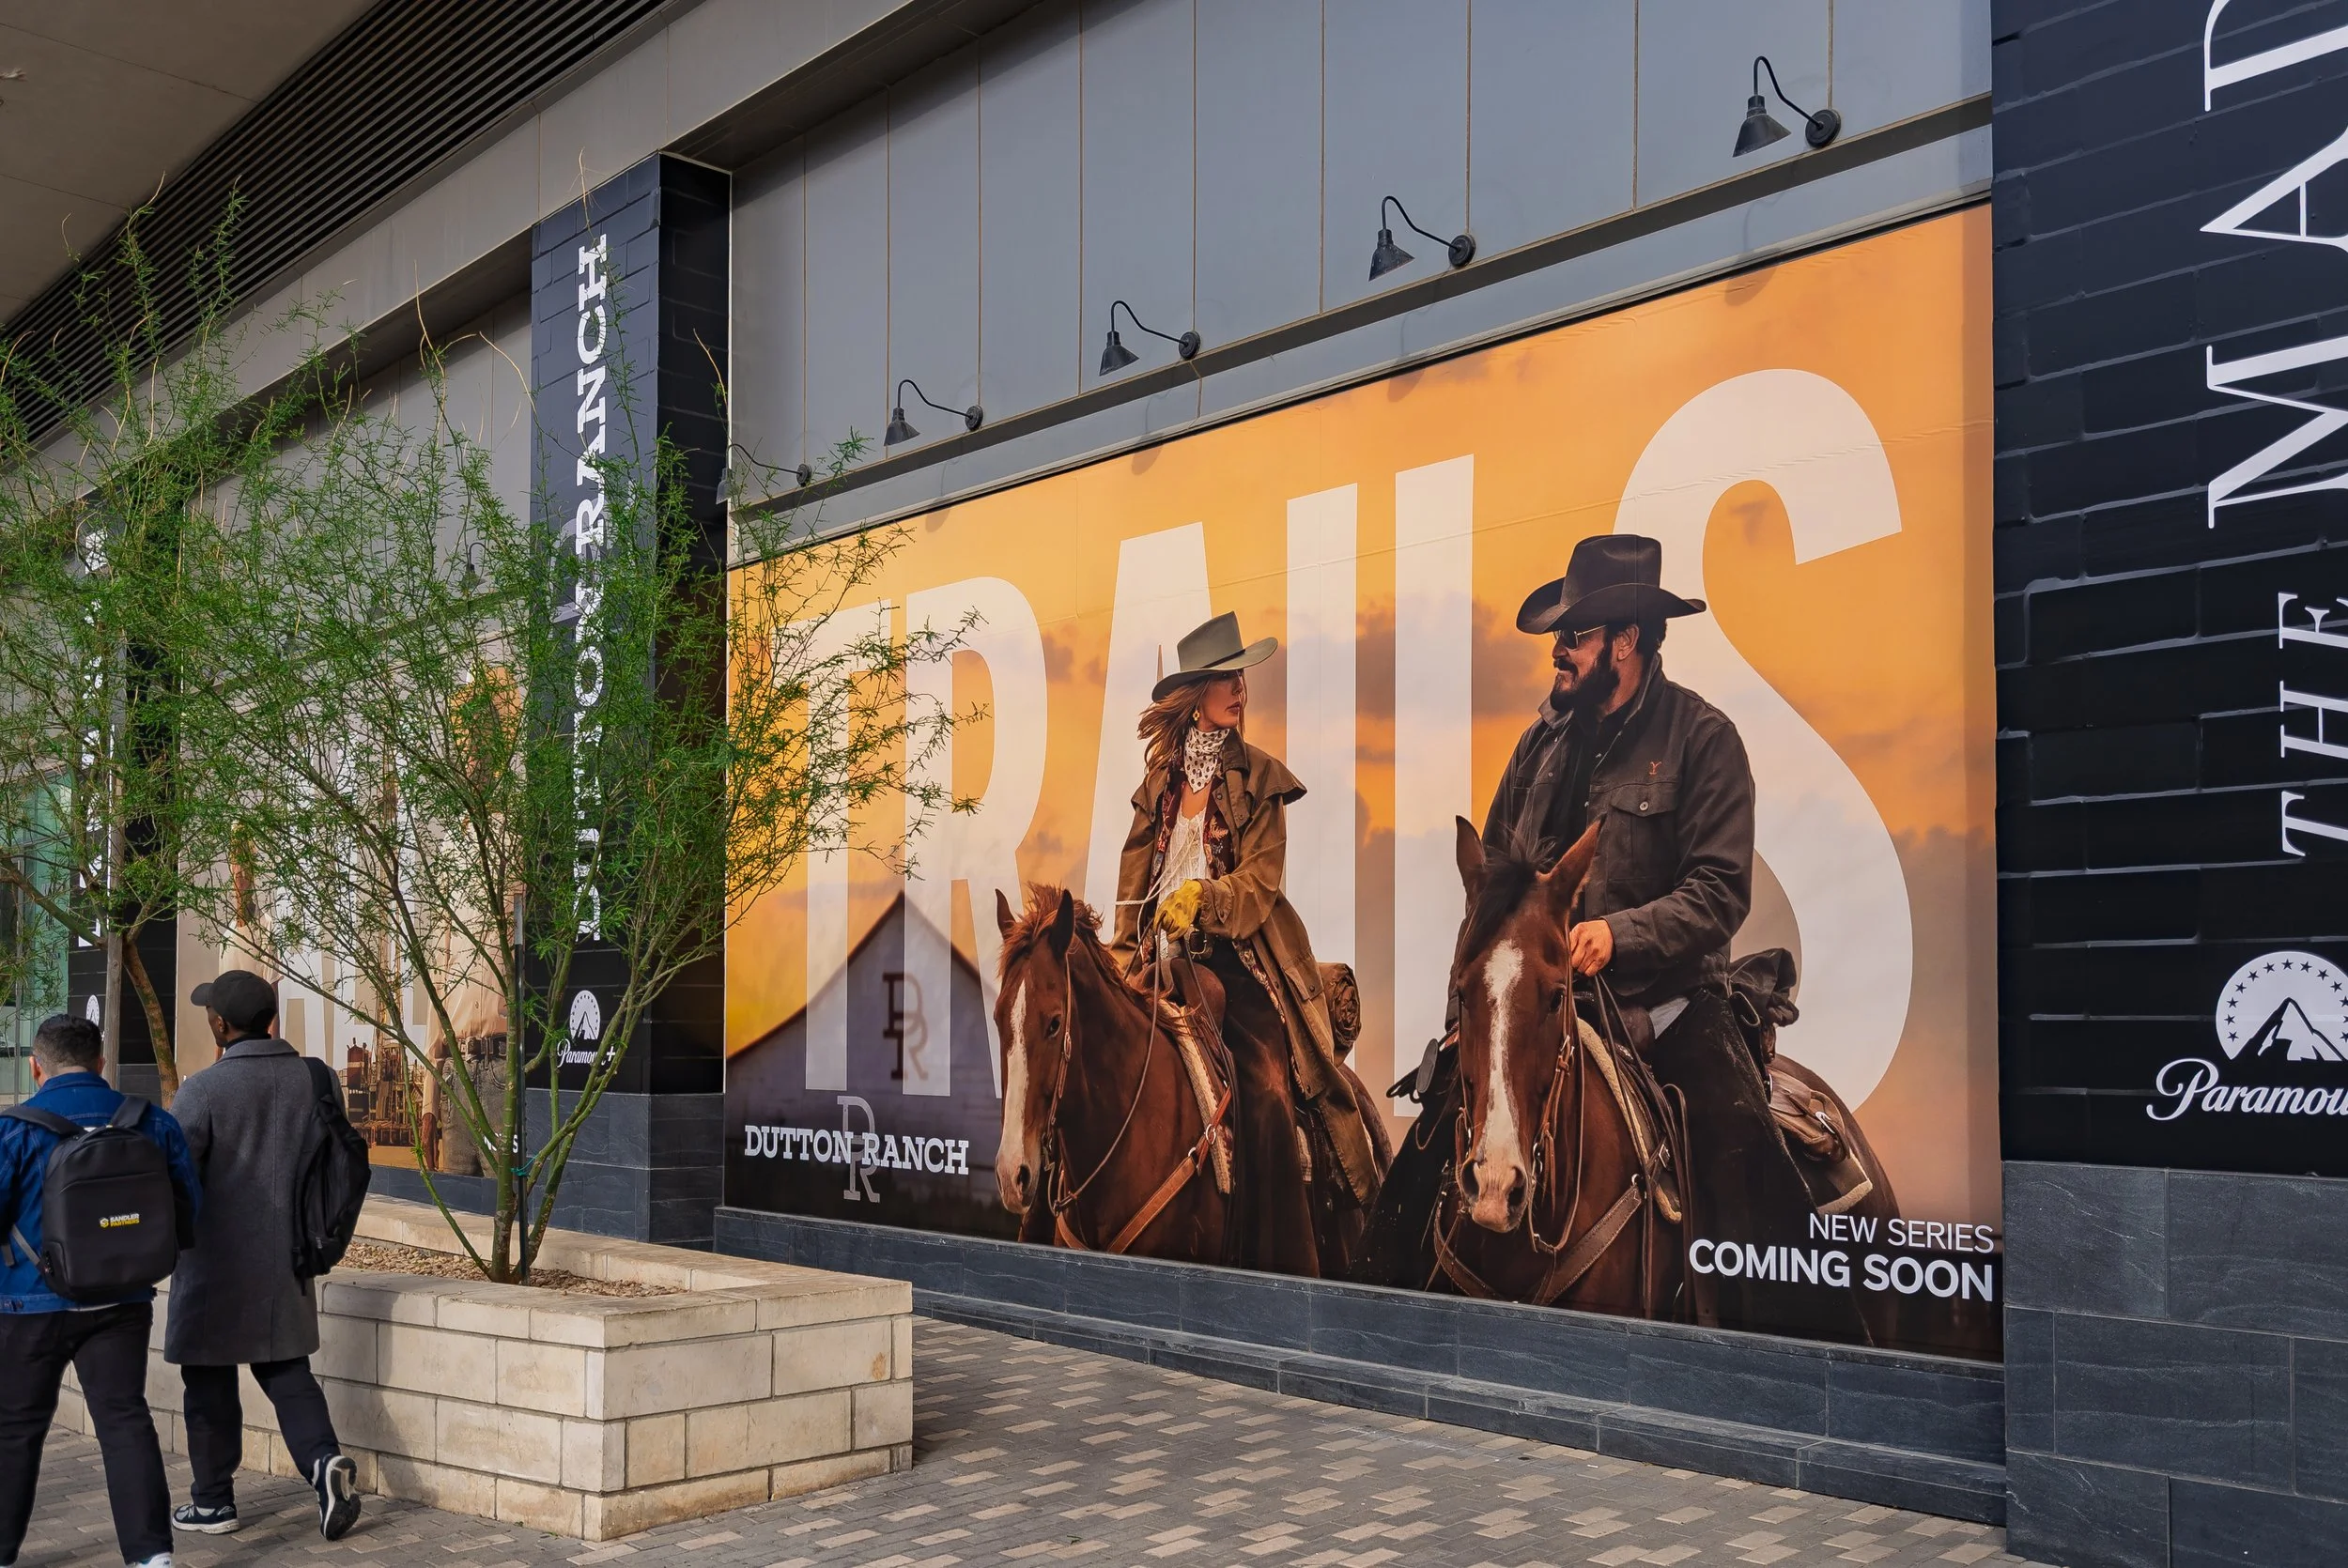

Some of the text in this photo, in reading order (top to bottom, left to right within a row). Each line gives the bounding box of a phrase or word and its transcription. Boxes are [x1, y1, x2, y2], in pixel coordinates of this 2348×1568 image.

[576, 234, 608, 554] RANCH
[771, 368, 1914, 1117] TRAILS
[744, 1125, 969, 1176] DUTTON RANCH
[110, 1213, 140, 1222] SANDLER
[1809, 1212, 1994, 1254] NEW SERIES
[1688, 1238, 1993, 1302] COMING SOON
